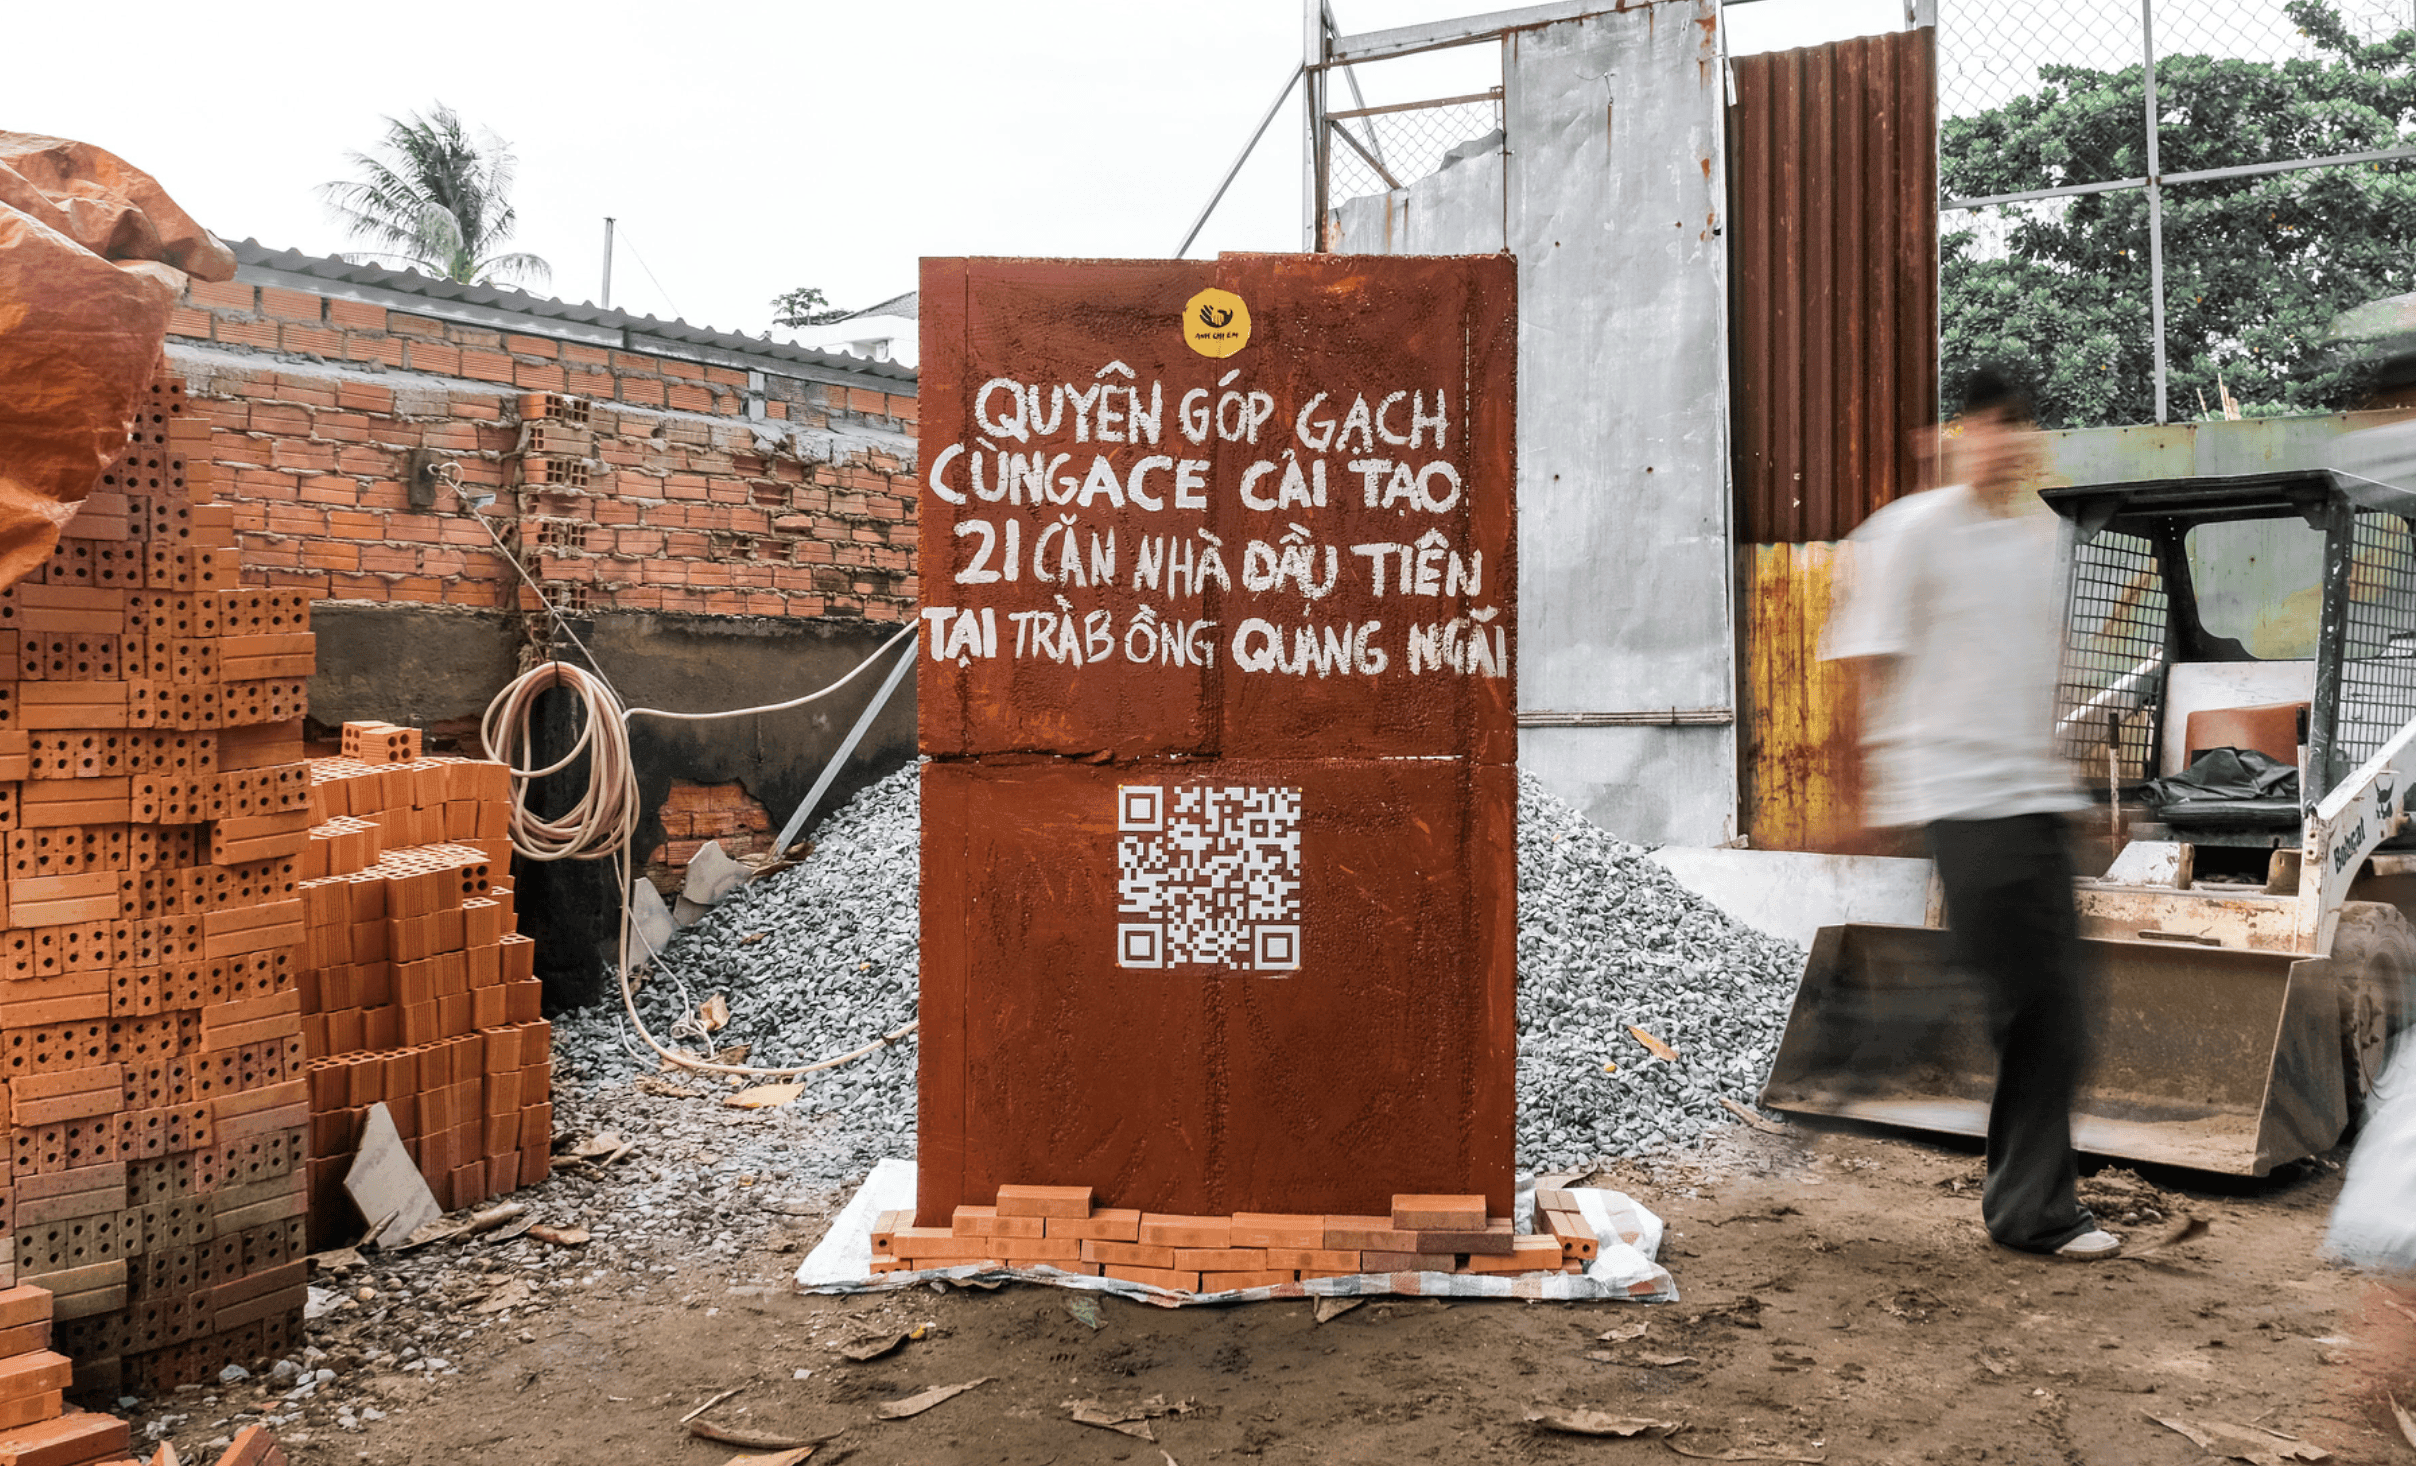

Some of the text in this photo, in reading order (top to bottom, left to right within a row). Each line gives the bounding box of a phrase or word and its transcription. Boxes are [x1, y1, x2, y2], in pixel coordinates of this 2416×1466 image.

[975, 360, 1448, 454] QUYÊN GÓP GẠCH
[1240, 448, 1327, 511] CẢI
[1348, 458, 1461, 516] TẠO
[953, 518, 1020, 584] 21
[1034, 513, 1115, 588] CĂN
[1133, 527, 1232, 600] NHÀ
[1350, 528, 1482, 597] TIÊN
[921, 607, 997, 668] TẠI
[2333, 816, 2366, 875] Bobcat
